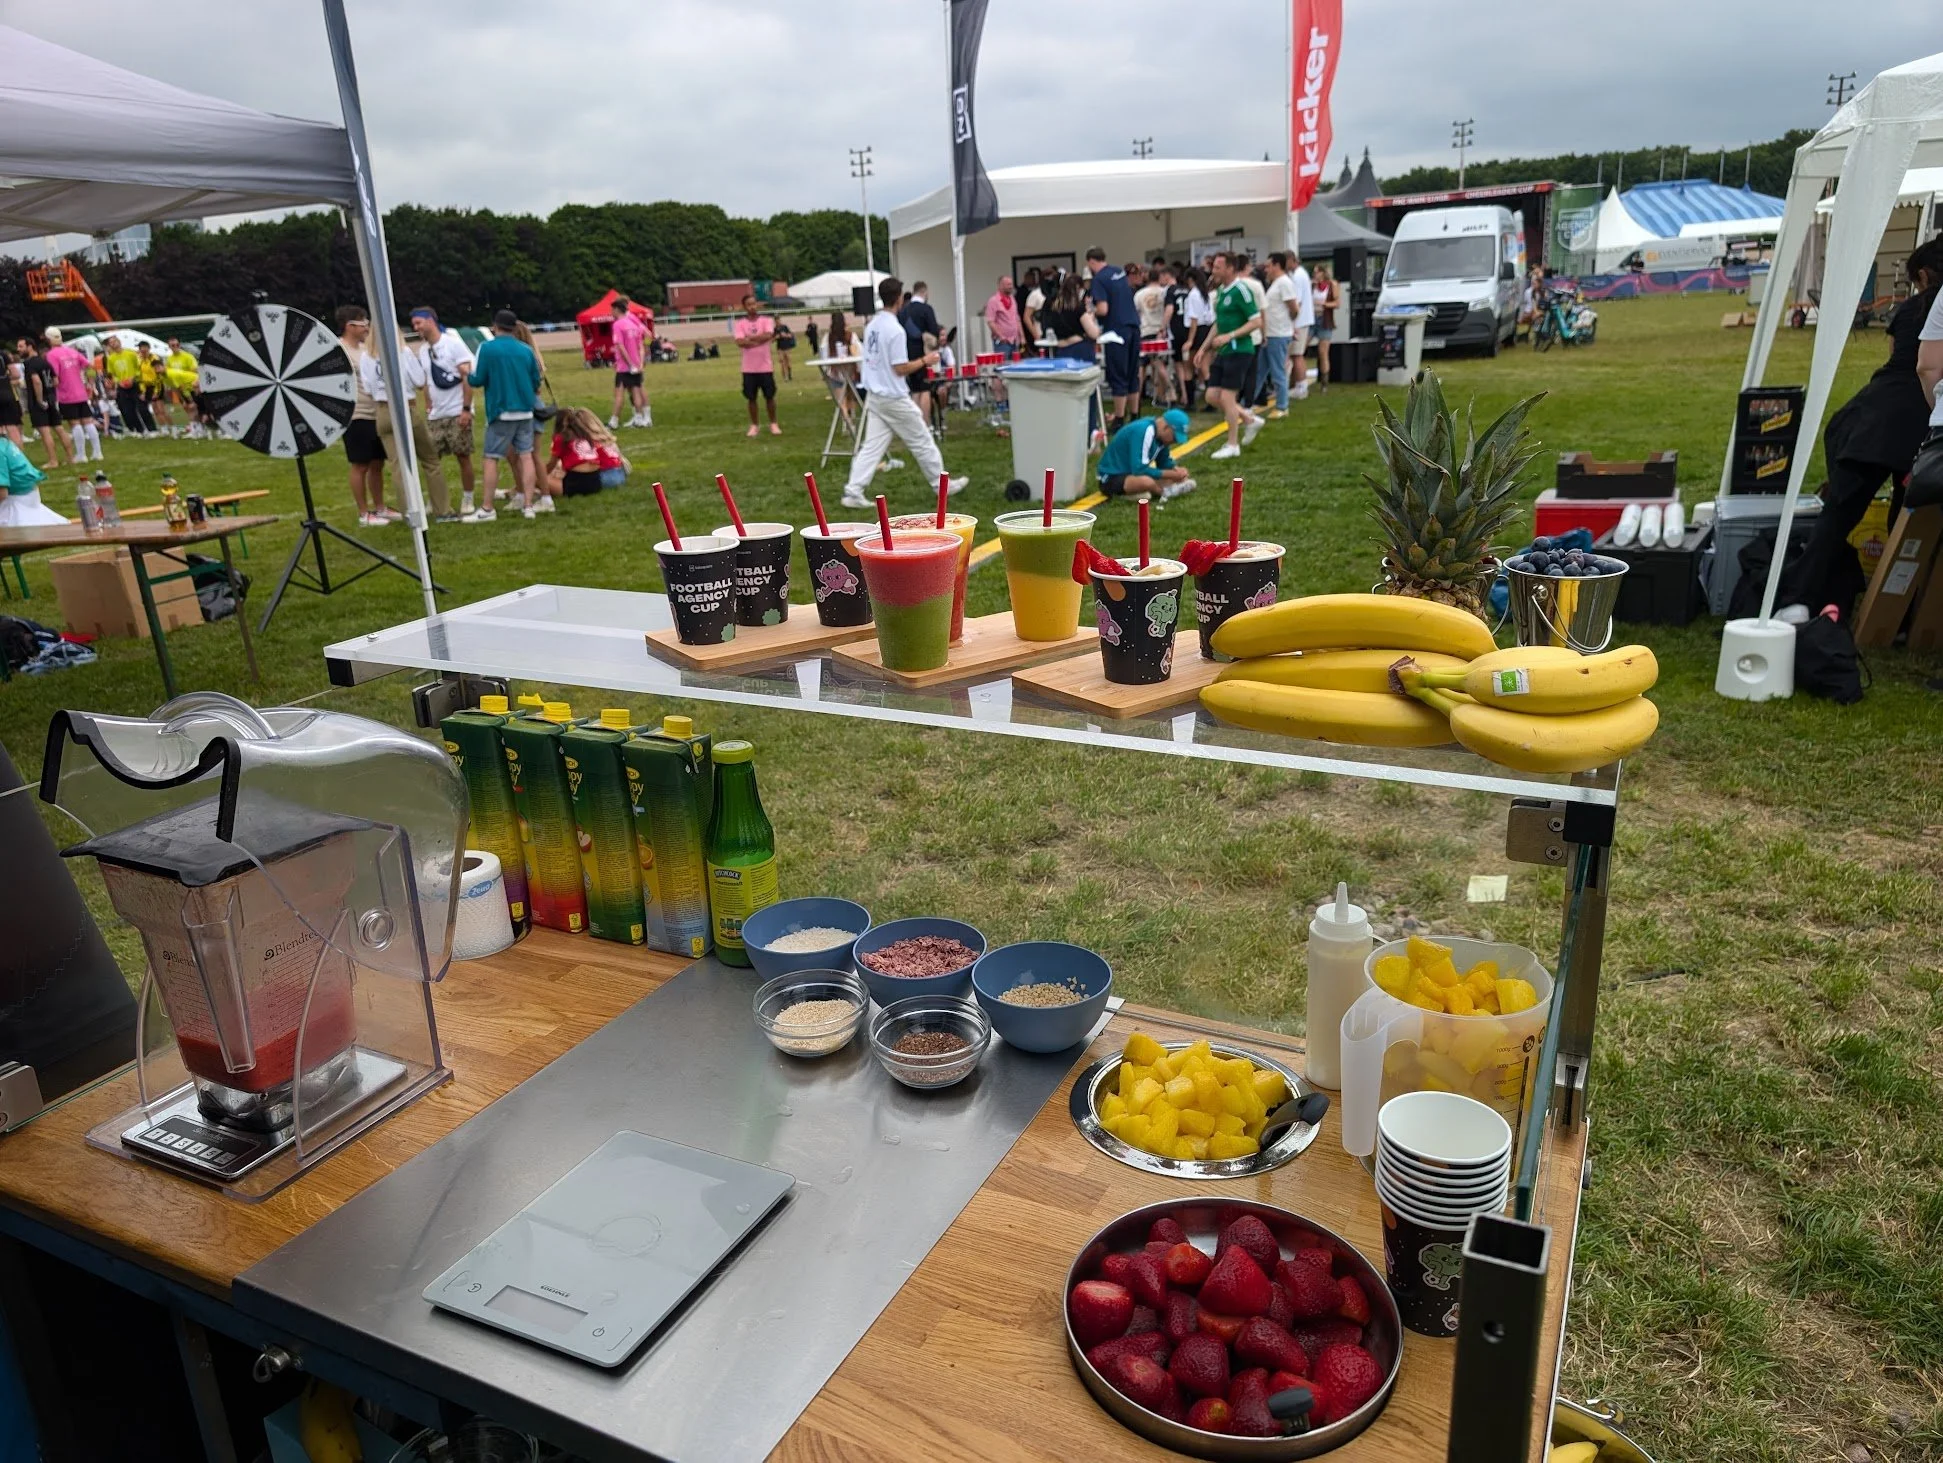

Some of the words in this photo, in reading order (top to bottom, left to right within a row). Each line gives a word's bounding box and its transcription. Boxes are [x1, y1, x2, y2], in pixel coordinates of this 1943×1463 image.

[1297, 26, 1329, 177] kicker
[1518, 184, 1534, 194] CUP
[736, 565, 776, 576] TBALL
[670, 577, 732, 593] FOOTBALL
[736, 575, 771, 586] ENCY
[677, 588, 730, 603] AGENCY
[1196, 591, 1229, 604] BALL
[690, 602, 720, 613] CUP
[1196, 601, 1223, 615] ENCY
[1198, 614, 1210, 624] UP
[171, 953, 198, 968] Blend
